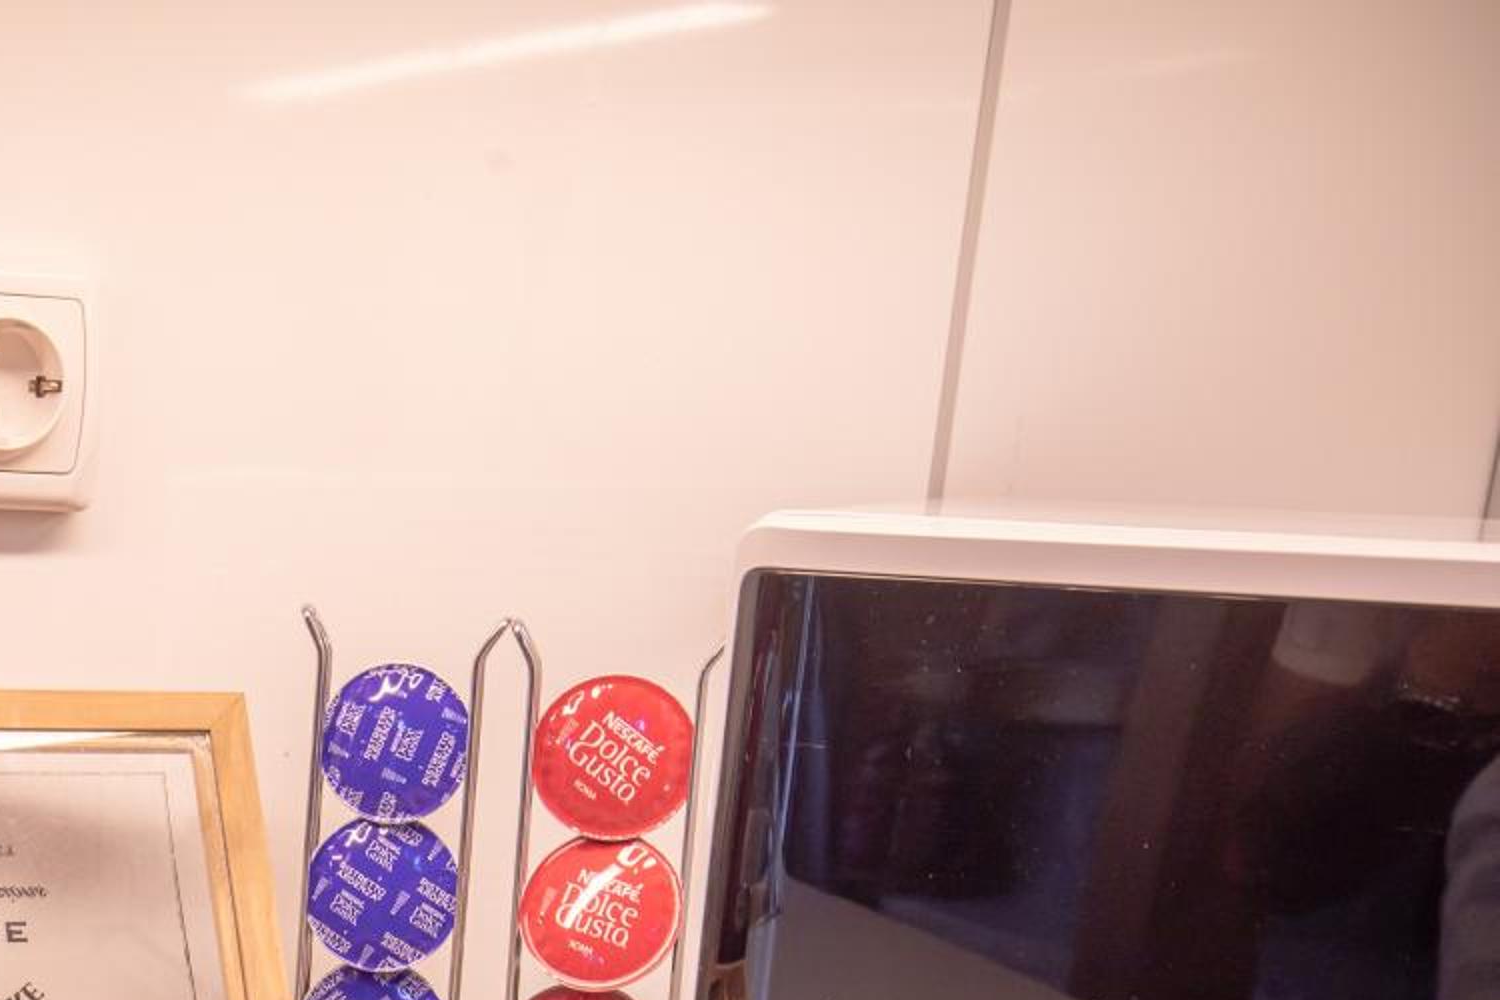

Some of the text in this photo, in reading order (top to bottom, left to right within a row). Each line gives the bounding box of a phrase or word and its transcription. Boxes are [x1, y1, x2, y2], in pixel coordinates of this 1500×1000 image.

[580, 720, 650, 786] Dolce
[602, 711, 665, 764] NESCAFÉ
[569, 741, 636, 804] Gusto
[577, 869, 643, 901] NCAFÉ
